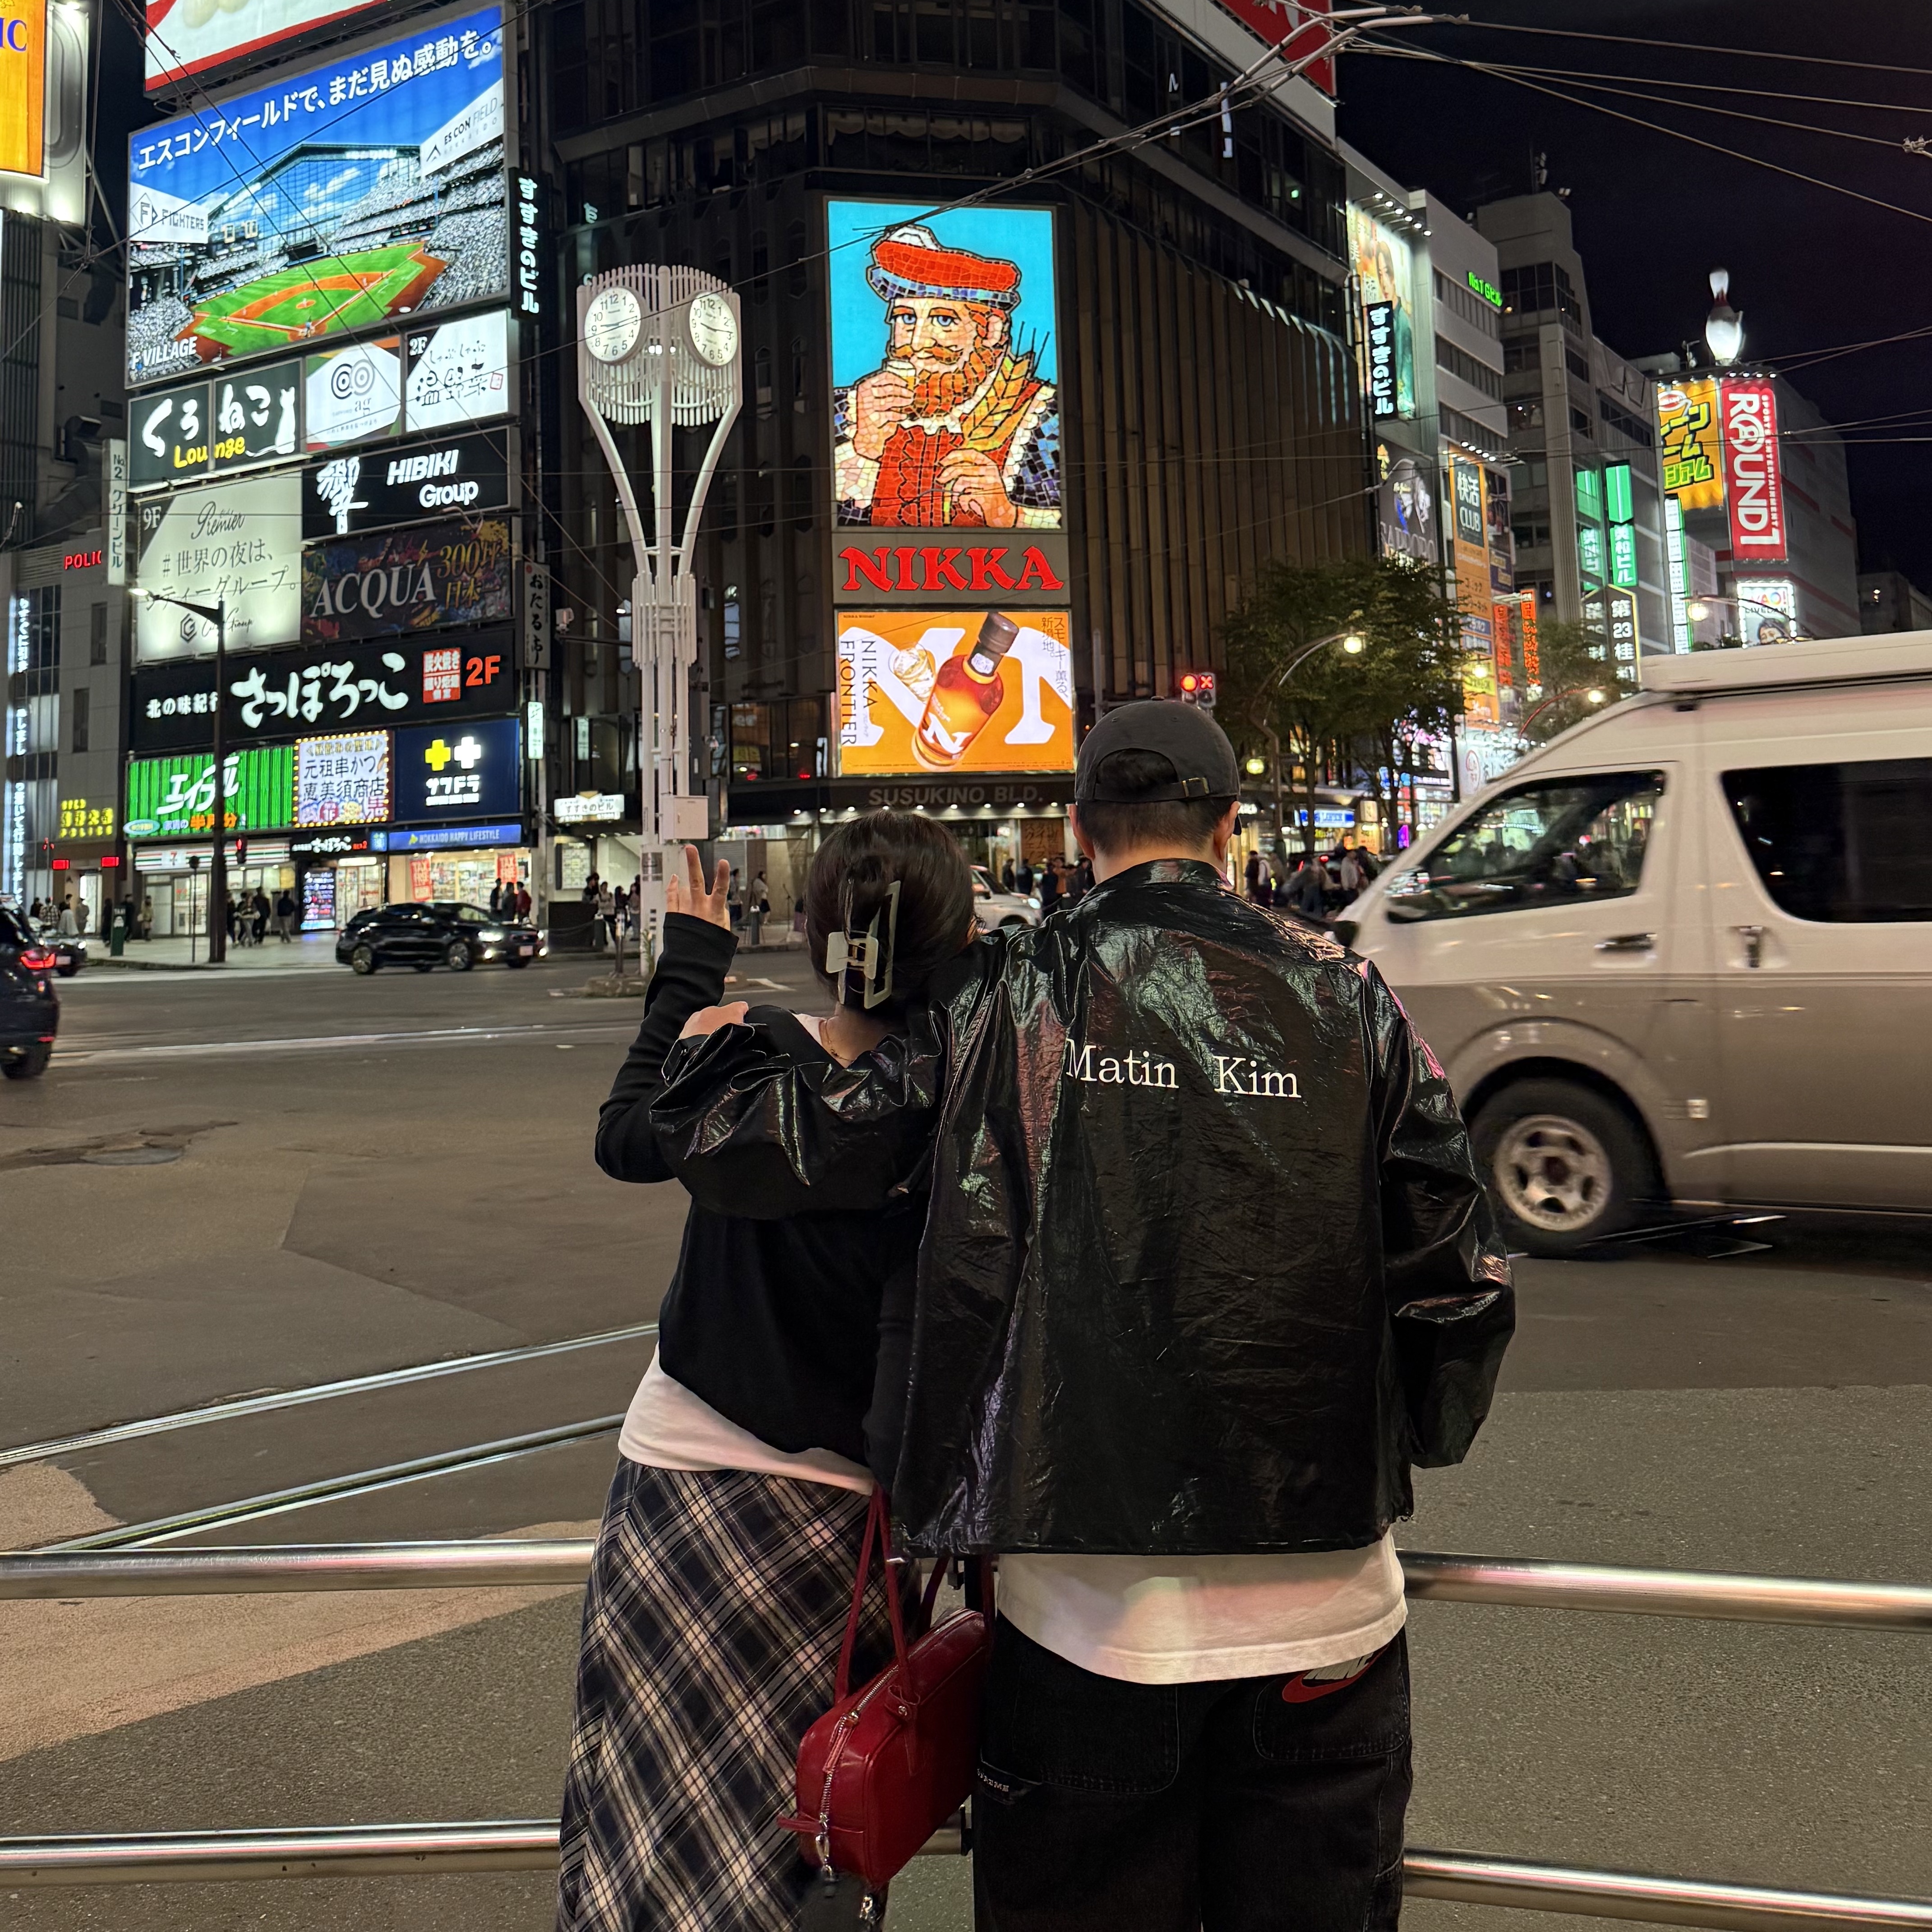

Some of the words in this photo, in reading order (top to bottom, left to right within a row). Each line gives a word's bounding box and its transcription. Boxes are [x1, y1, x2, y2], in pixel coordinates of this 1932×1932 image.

[138, 30, 492, 170] エスコンフィールドで、まだ見ぬ感動を。
[162, 208, 204, 231] FIGHTERS
[143, 336, 198, 367] VILLAGE
[409, 336, 428, 356] 2F
[142, 384, 271, 457] くろねこ
[1761, 394, 1770, 436] SPORTS
[173, 436, 245, 468] Lounge
[387, 449, 459, 486] HIBIKI
[1729, 393, 1780, 545] ROUND1
[419, 481, 479, 508] Group
[1457, 471, 1480, 507] 快活
[1765, 439, 1779, 528] ENTERTAINMENT
[143, 506, 162, 531] 9F
[191, 501, 245, 540] Premier
[1459, 506, 1481, 533] CLUB
[839, 546, 1064, 592] NIKKA
[309, 561, 437, 619] ACQUA
[466, 655, 500, 687] 2F
[861, 640, 878, 708] NIKKA
[230, 652, 409, 728] さっぽろっこ
[840, 640, 857, 746] FRONTIER
[304, 756, 376, 779] 元祖串かつ
[303, 776, 385, 801] 恵美須商店
[869, 786, 985, 806] SUSUKINO
[994, 785, 1044, 803] BLD.
[419, 833, 449, 844] HOKKAIDO
[450, 832, 469, 843] HAPPY
[470, 829, 500, 841] LIFESTYLE
[1065, 1038, 1179, 1090] Matin
[1213, 1055, 1302, 1099] Kim
